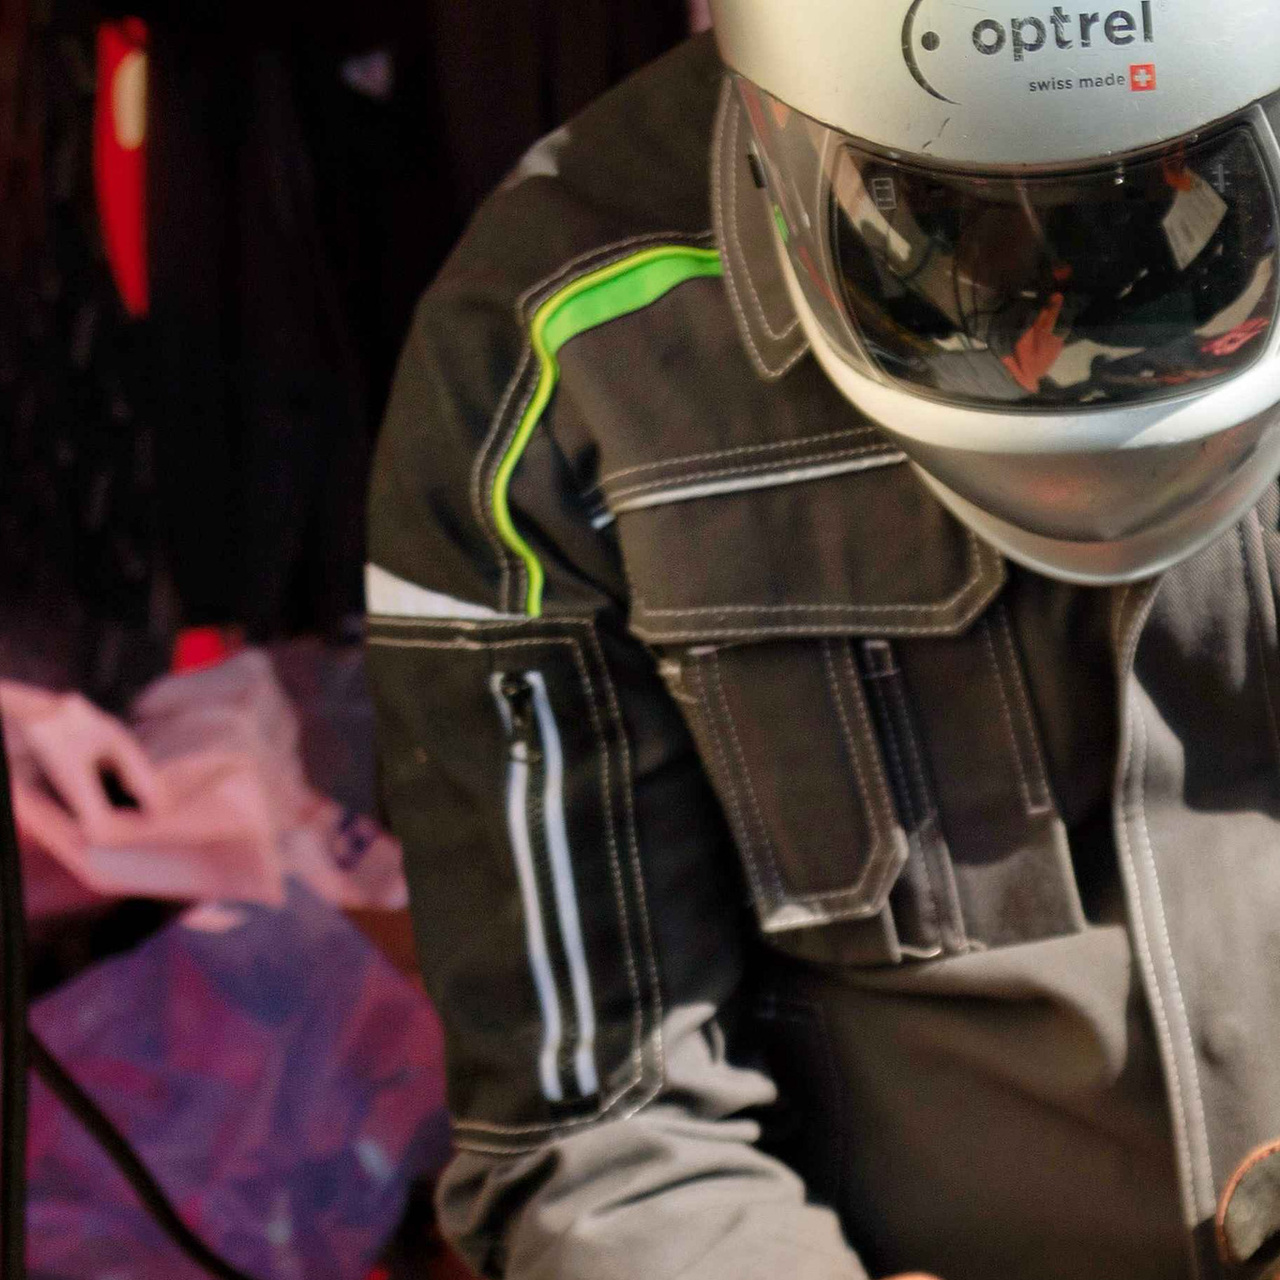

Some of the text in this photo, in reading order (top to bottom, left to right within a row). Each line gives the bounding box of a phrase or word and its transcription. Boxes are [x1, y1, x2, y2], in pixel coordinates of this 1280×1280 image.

[972, 0, 1154, 62] optrel
[1029, 73, 1126, 92] swiss made
